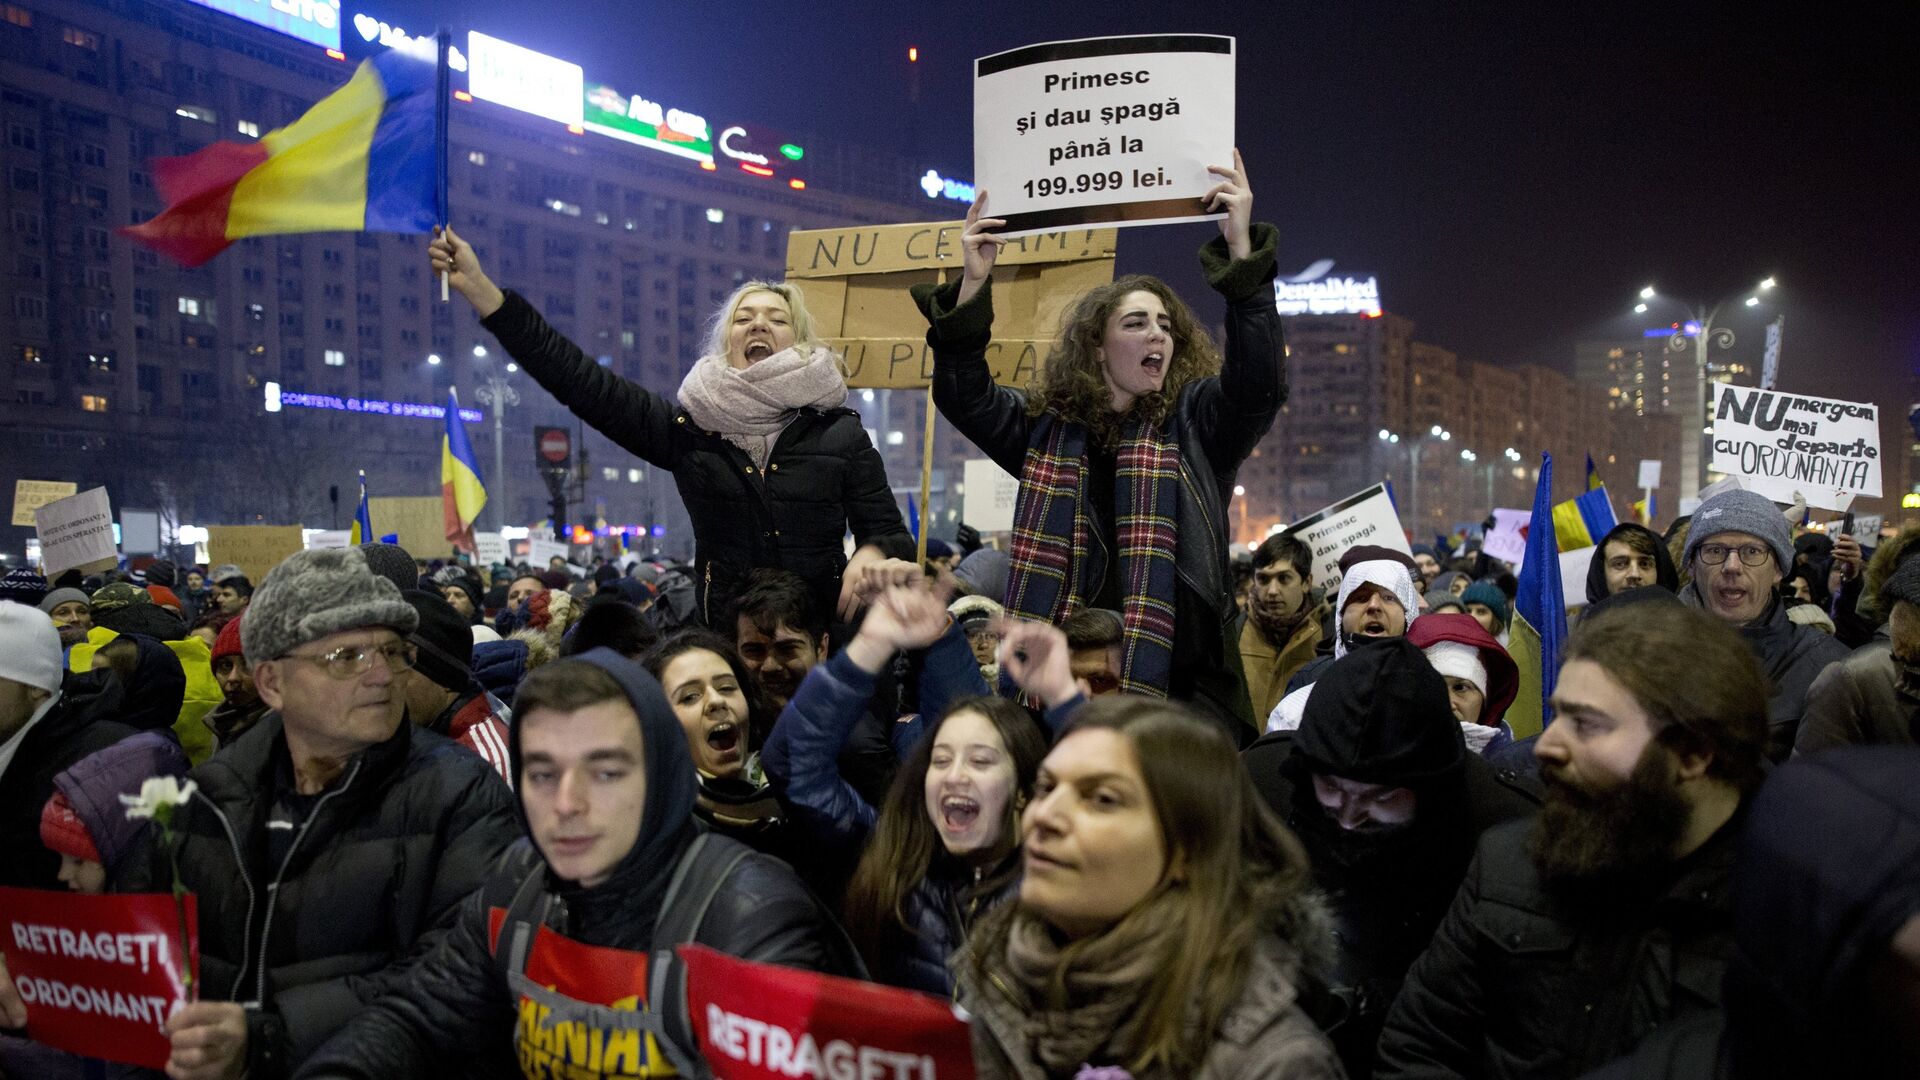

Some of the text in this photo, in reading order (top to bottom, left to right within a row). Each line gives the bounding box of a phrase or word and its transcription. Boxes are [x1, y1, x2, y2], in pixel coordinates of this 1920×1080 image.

[1045, 70, 1150, 93] Primesc
[1045, 108, 1091, 128] dau
[1049, 135, 1144, 166] până la
[1023, 167, 1173, 198] 199.999 lei.
[812, 233, 879, 270] NU
[1716, 387, 1875, 431] NU mergem
[1782, 418, 1818, 436] mai
[1776, 433, 1878, 459] departe
[1308, 515, 1358, 543] Primesc
[1316, 543, 1338, 557] dau
[11, 921, 169, 974] RETRAGEȚI
